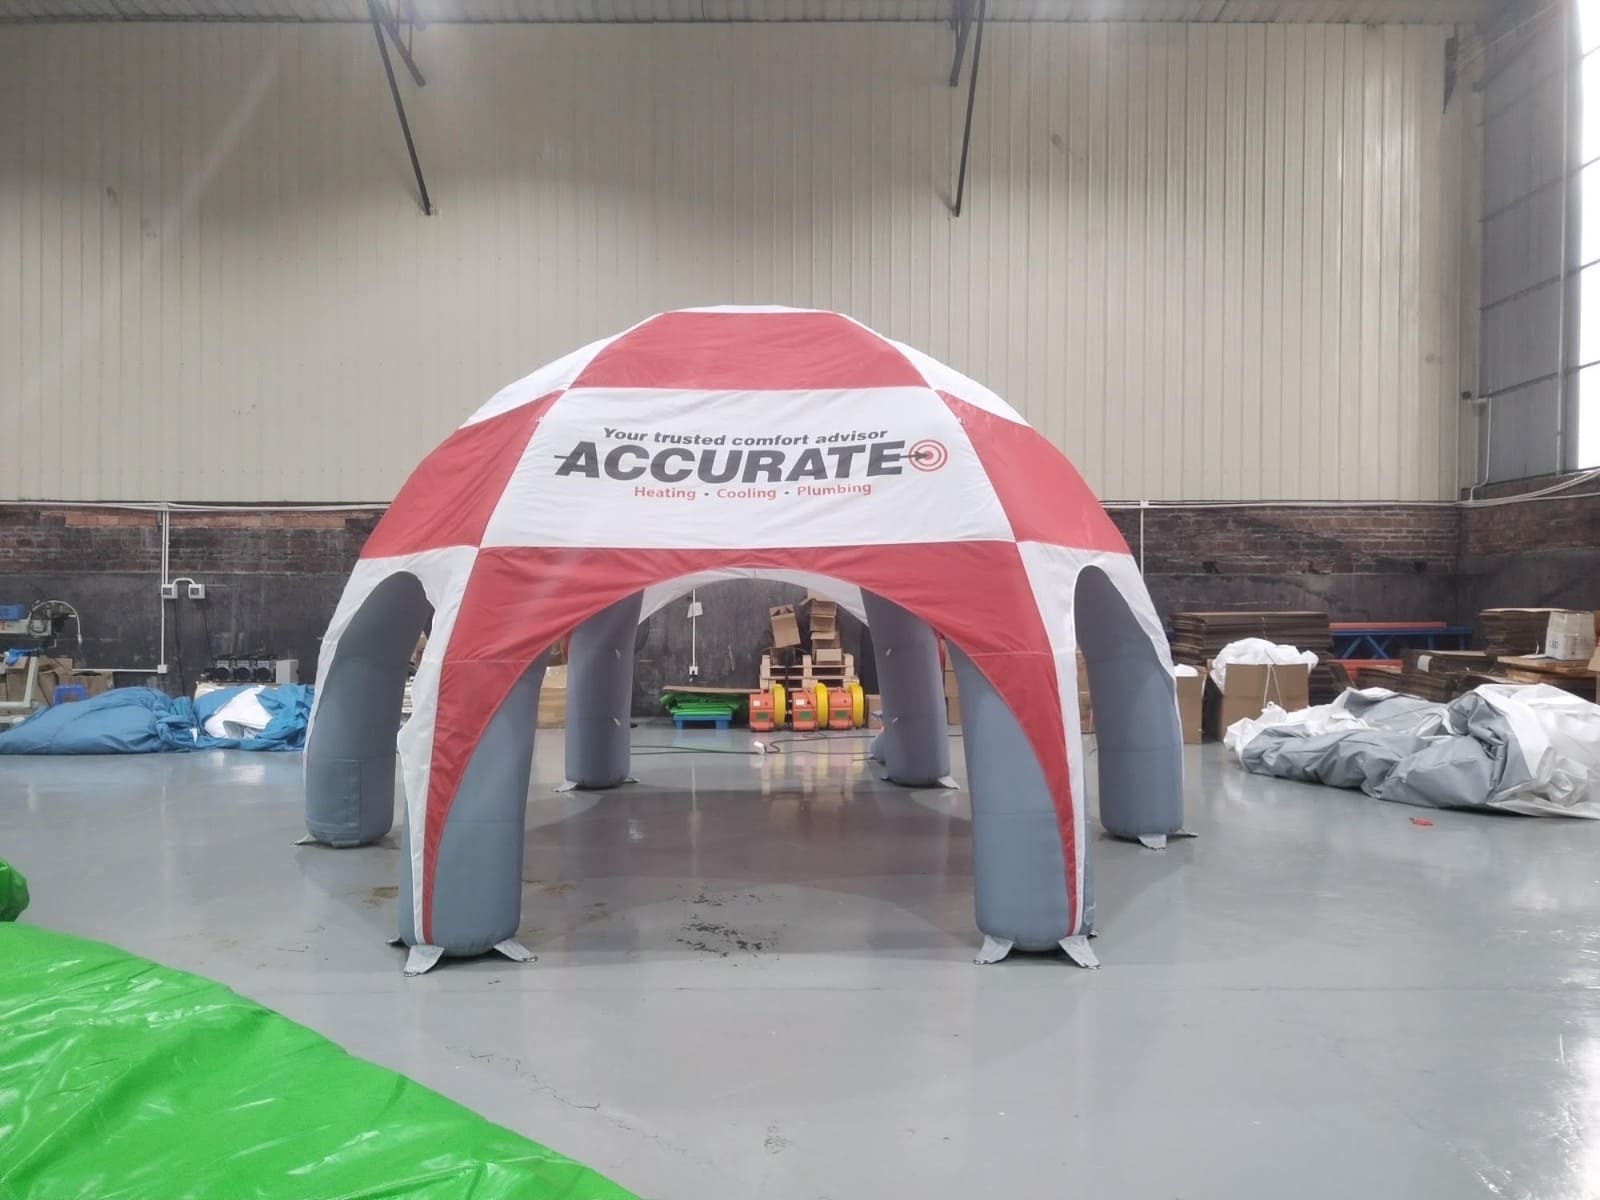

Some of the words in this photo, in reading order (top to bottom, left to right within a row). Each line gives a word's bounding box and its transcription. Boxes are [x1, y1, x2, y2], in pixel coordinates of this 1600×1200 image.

[604, 428, 648, 441] Your
[653, 432, 726, 446] trusted
[731, 434, 809, 446] comfort
[816, 429, 888, 444] advisor
[555, 440, 905, 484] ACCURATE
[634, 486, 697, 501] Heating
[717, 488, 777, 501] Cooling
[797, 484, 872, 497] Plumbing
